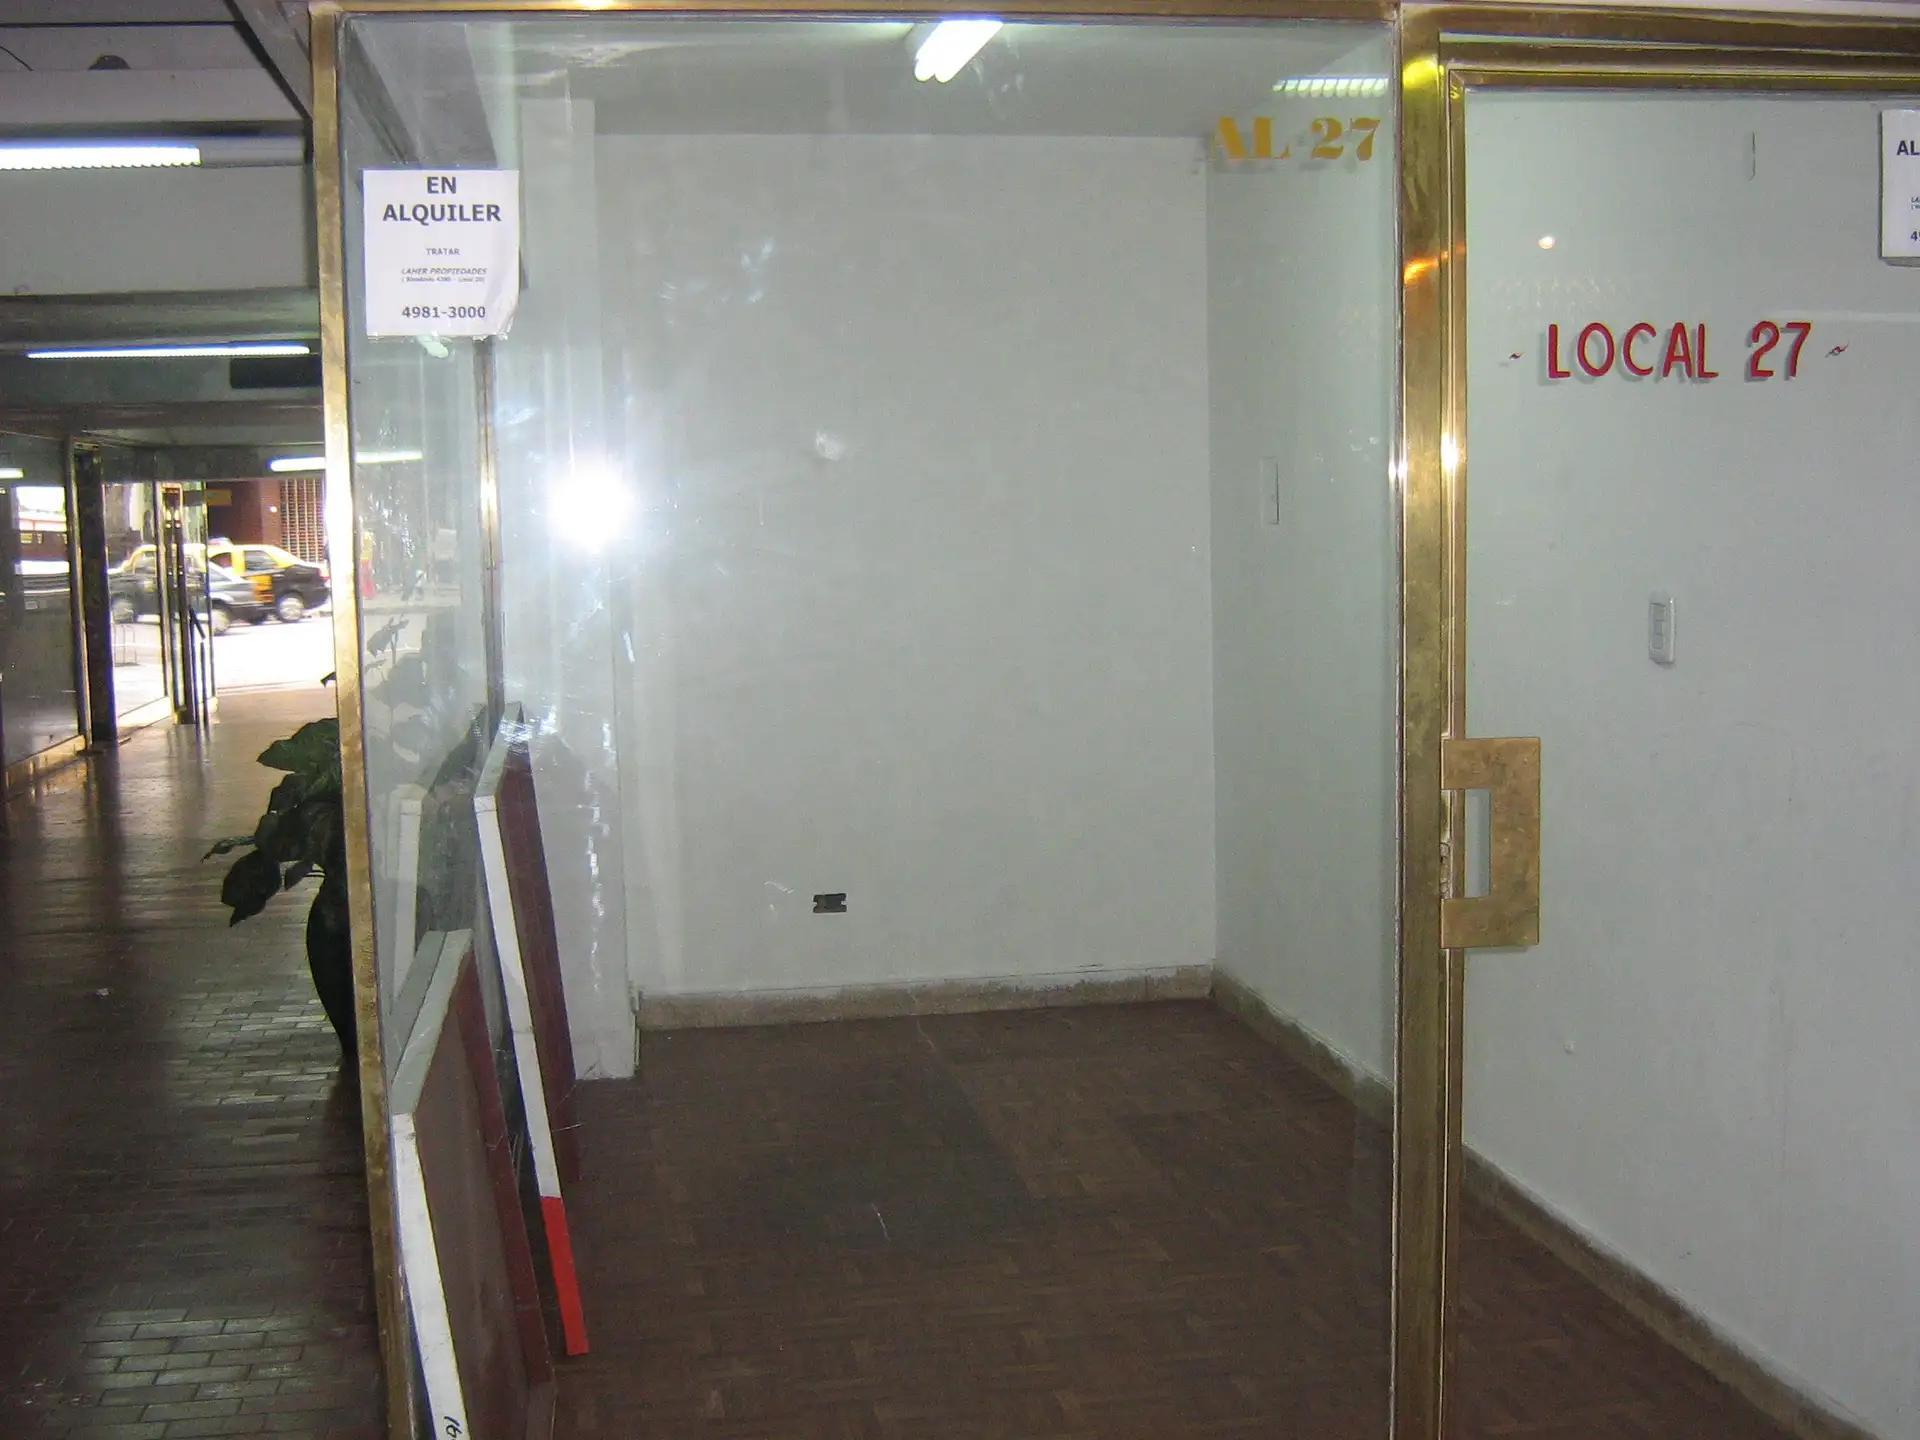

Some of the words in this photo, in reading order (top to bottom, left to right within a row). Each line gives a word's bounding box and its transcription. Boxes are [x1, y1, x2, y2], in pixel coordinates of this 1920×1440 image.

[1311, 116, 1381, 161] 27
[427, 176, 457, 194] EN
[383, 204, 501, 226] ALQUILER
[426, 248, 460, 256] TRATAR
[430, 267, 487, 275] PROPIEDADES
[401, 306, 486, 318] 4981-3000
[1548, 322, 1719, 378] LOCAL
[1751, 321, 1812, 378] 27
